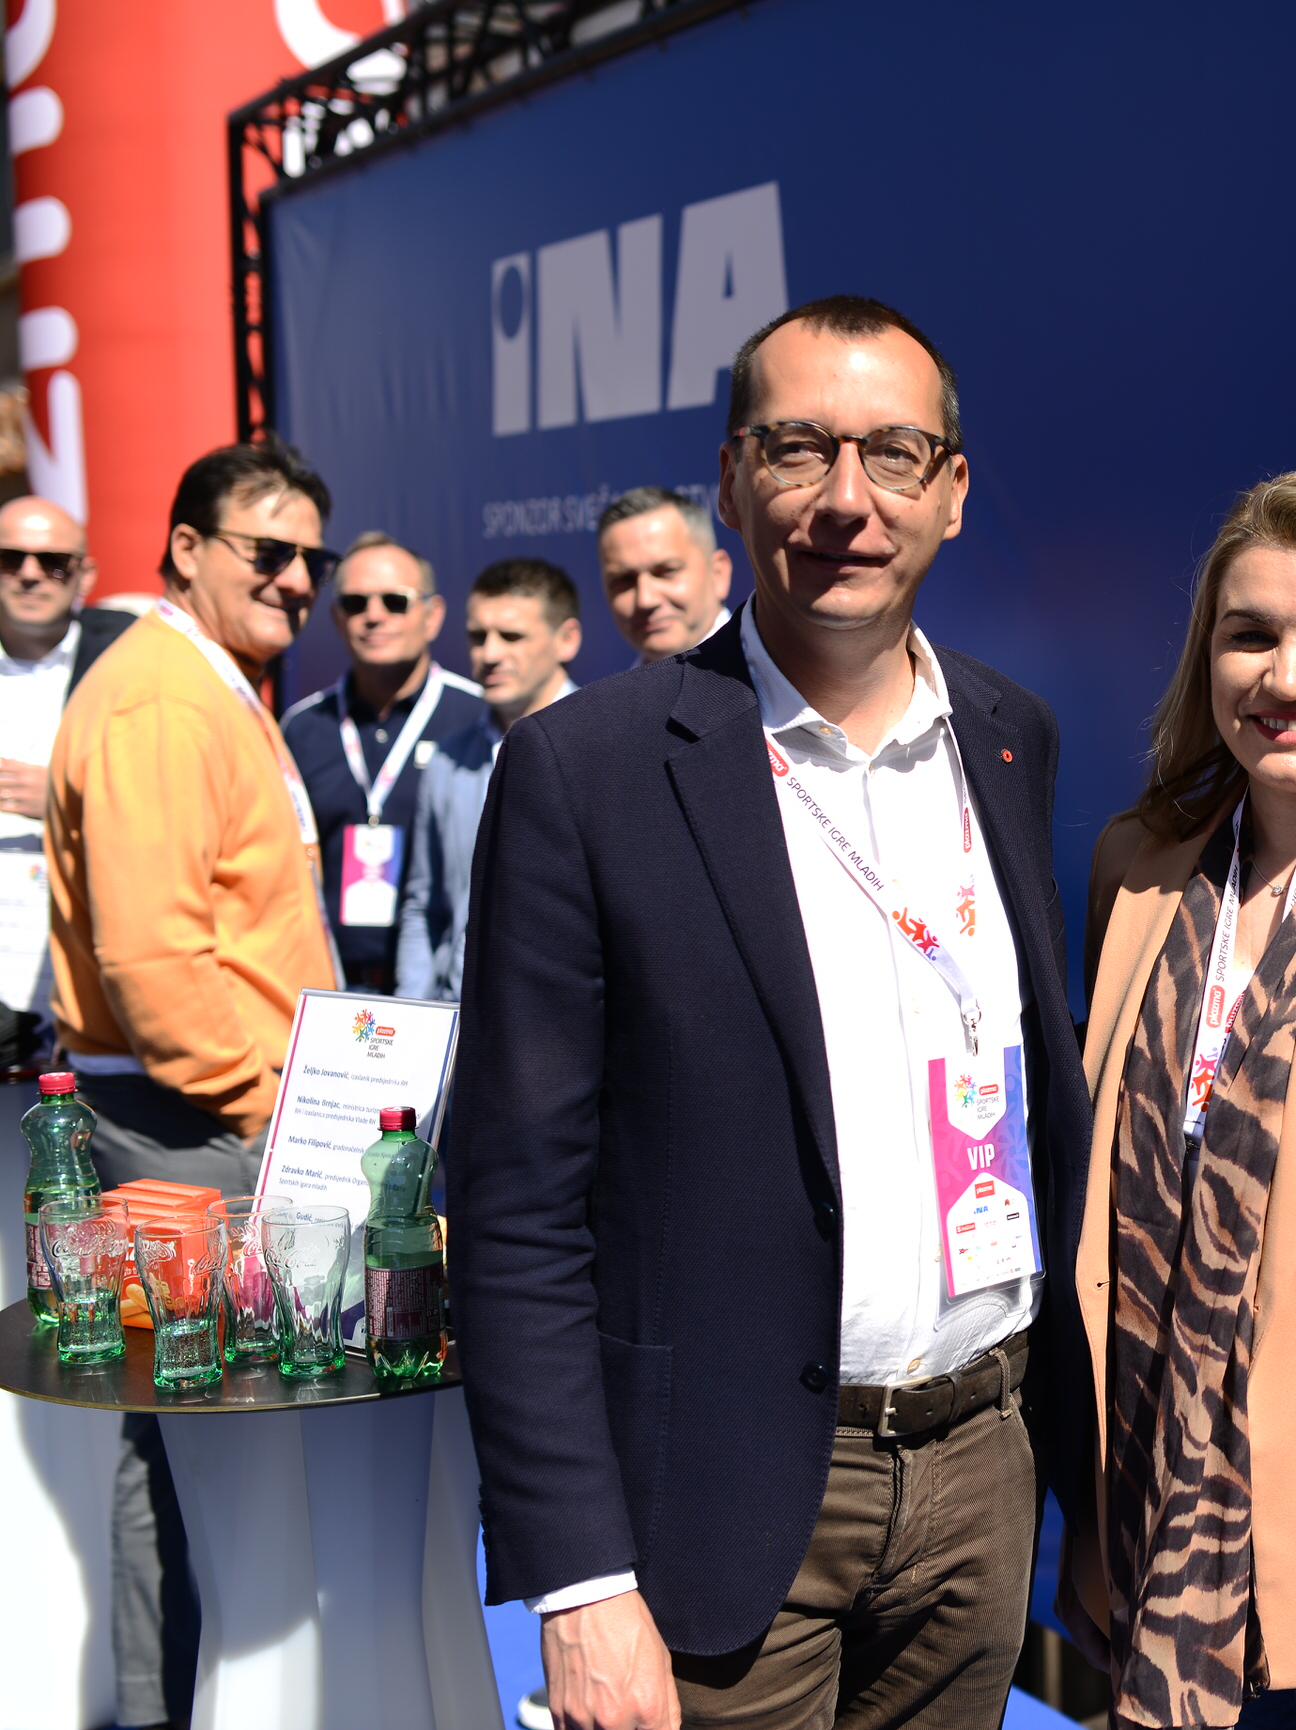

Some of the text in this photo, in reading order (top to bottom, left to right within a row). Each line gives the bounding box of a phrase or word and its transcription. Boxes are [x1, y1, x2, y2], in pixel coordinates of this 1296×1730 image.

[786, 777, 885, 891] SPORTSKE IGRE MLADIH
[1215, 864, 1239, 982] SPORTSKE IGRE MLADIH
[1209, 990, 1222, 1025] plazma
[370, 1037, 394, 1046] SPORTSKE
[367, 1051, 385, 1059] MLADIH
[303, 1064, 320, 1076] Željko
[296, 1095, 320, 1106] Nikolina
[355, 1116, 368, 1124] Vlade
[288, 1135, 307, 1145] Marko
[967, 1144, 995, 1170] VIP
[281, 1165, 304, 1176] Zdravko
